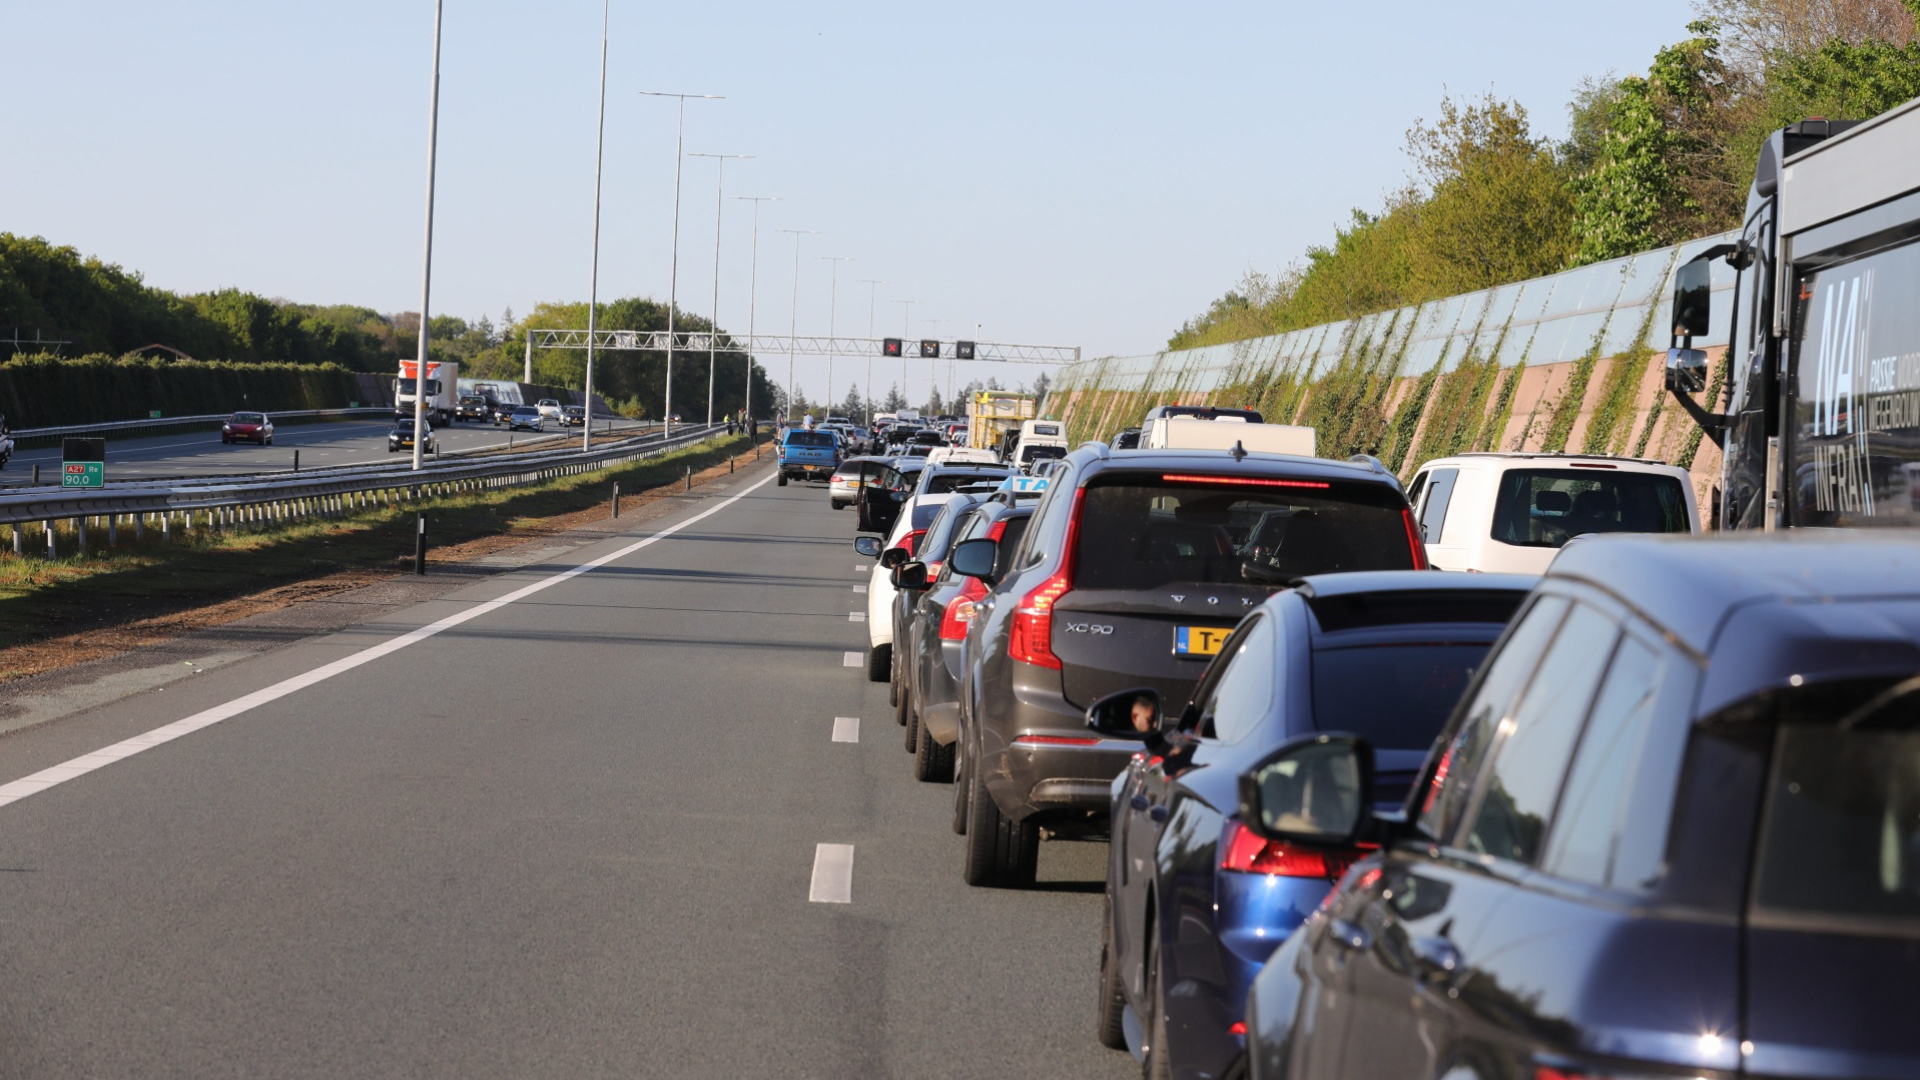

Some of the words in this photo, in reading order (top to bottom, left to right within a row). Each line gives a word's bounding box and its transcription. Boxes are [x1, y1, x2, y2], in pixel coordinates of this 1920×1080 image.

[1869, 356, 1897, 393] PASSIE
[1868, 390, 1919, 432] WEGENBOUW
[67, 465, 84, 474] A27
[88, 465, 99, 473] Re
[65, 475, 90, 485] 90.0
[1016, 478, 1049, 491] TA
[1814, 444, 1861, 512] INFRA
[1171, 595, 1253, 606] VOL
[1065, 622, 1114, 635] XC90
[1177, 642, 1188, 650] NL
